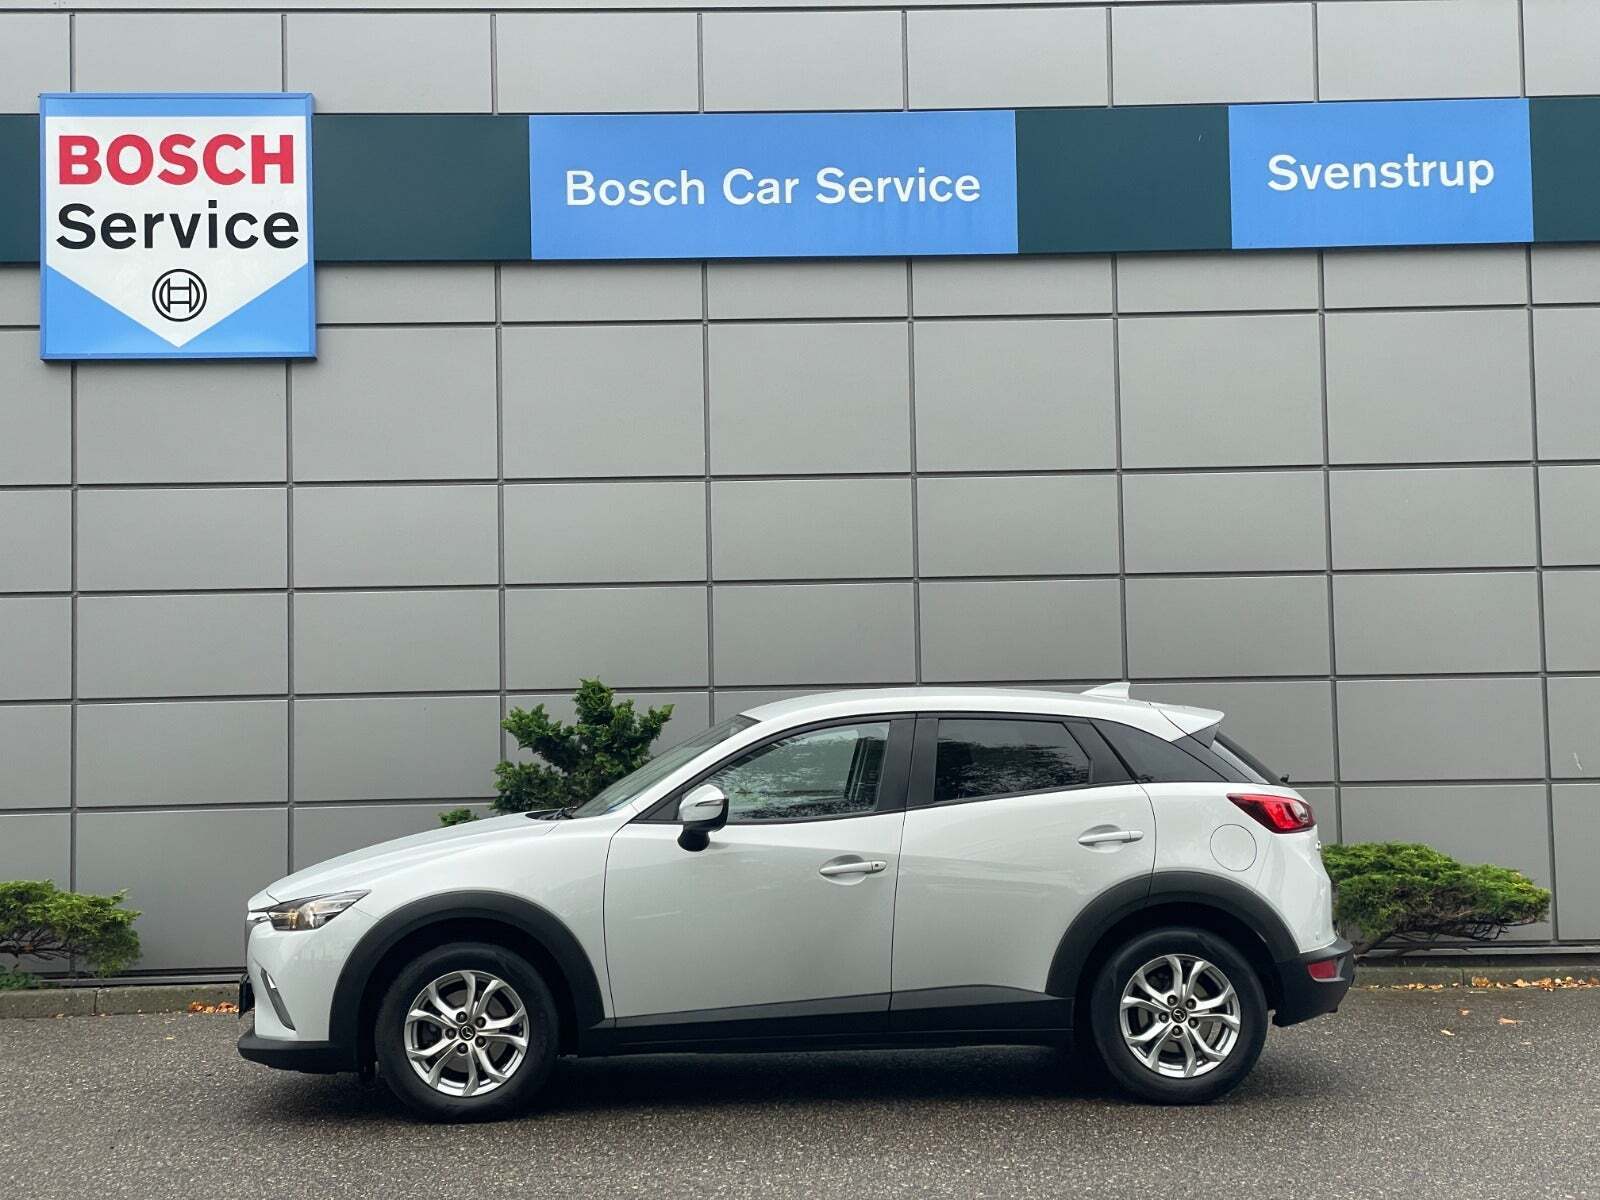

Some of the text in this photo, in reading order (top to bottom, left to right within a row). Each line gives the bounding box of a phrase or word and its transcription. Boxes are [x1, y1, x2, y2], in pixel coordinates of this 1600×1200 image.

[58, 133, 295, 186] BOSCH
[1267, 153, 1495, 194] Svenstrup
[565, 165, 981, 207] Bosch Car Service
[55, 199, 300, 250] Service
